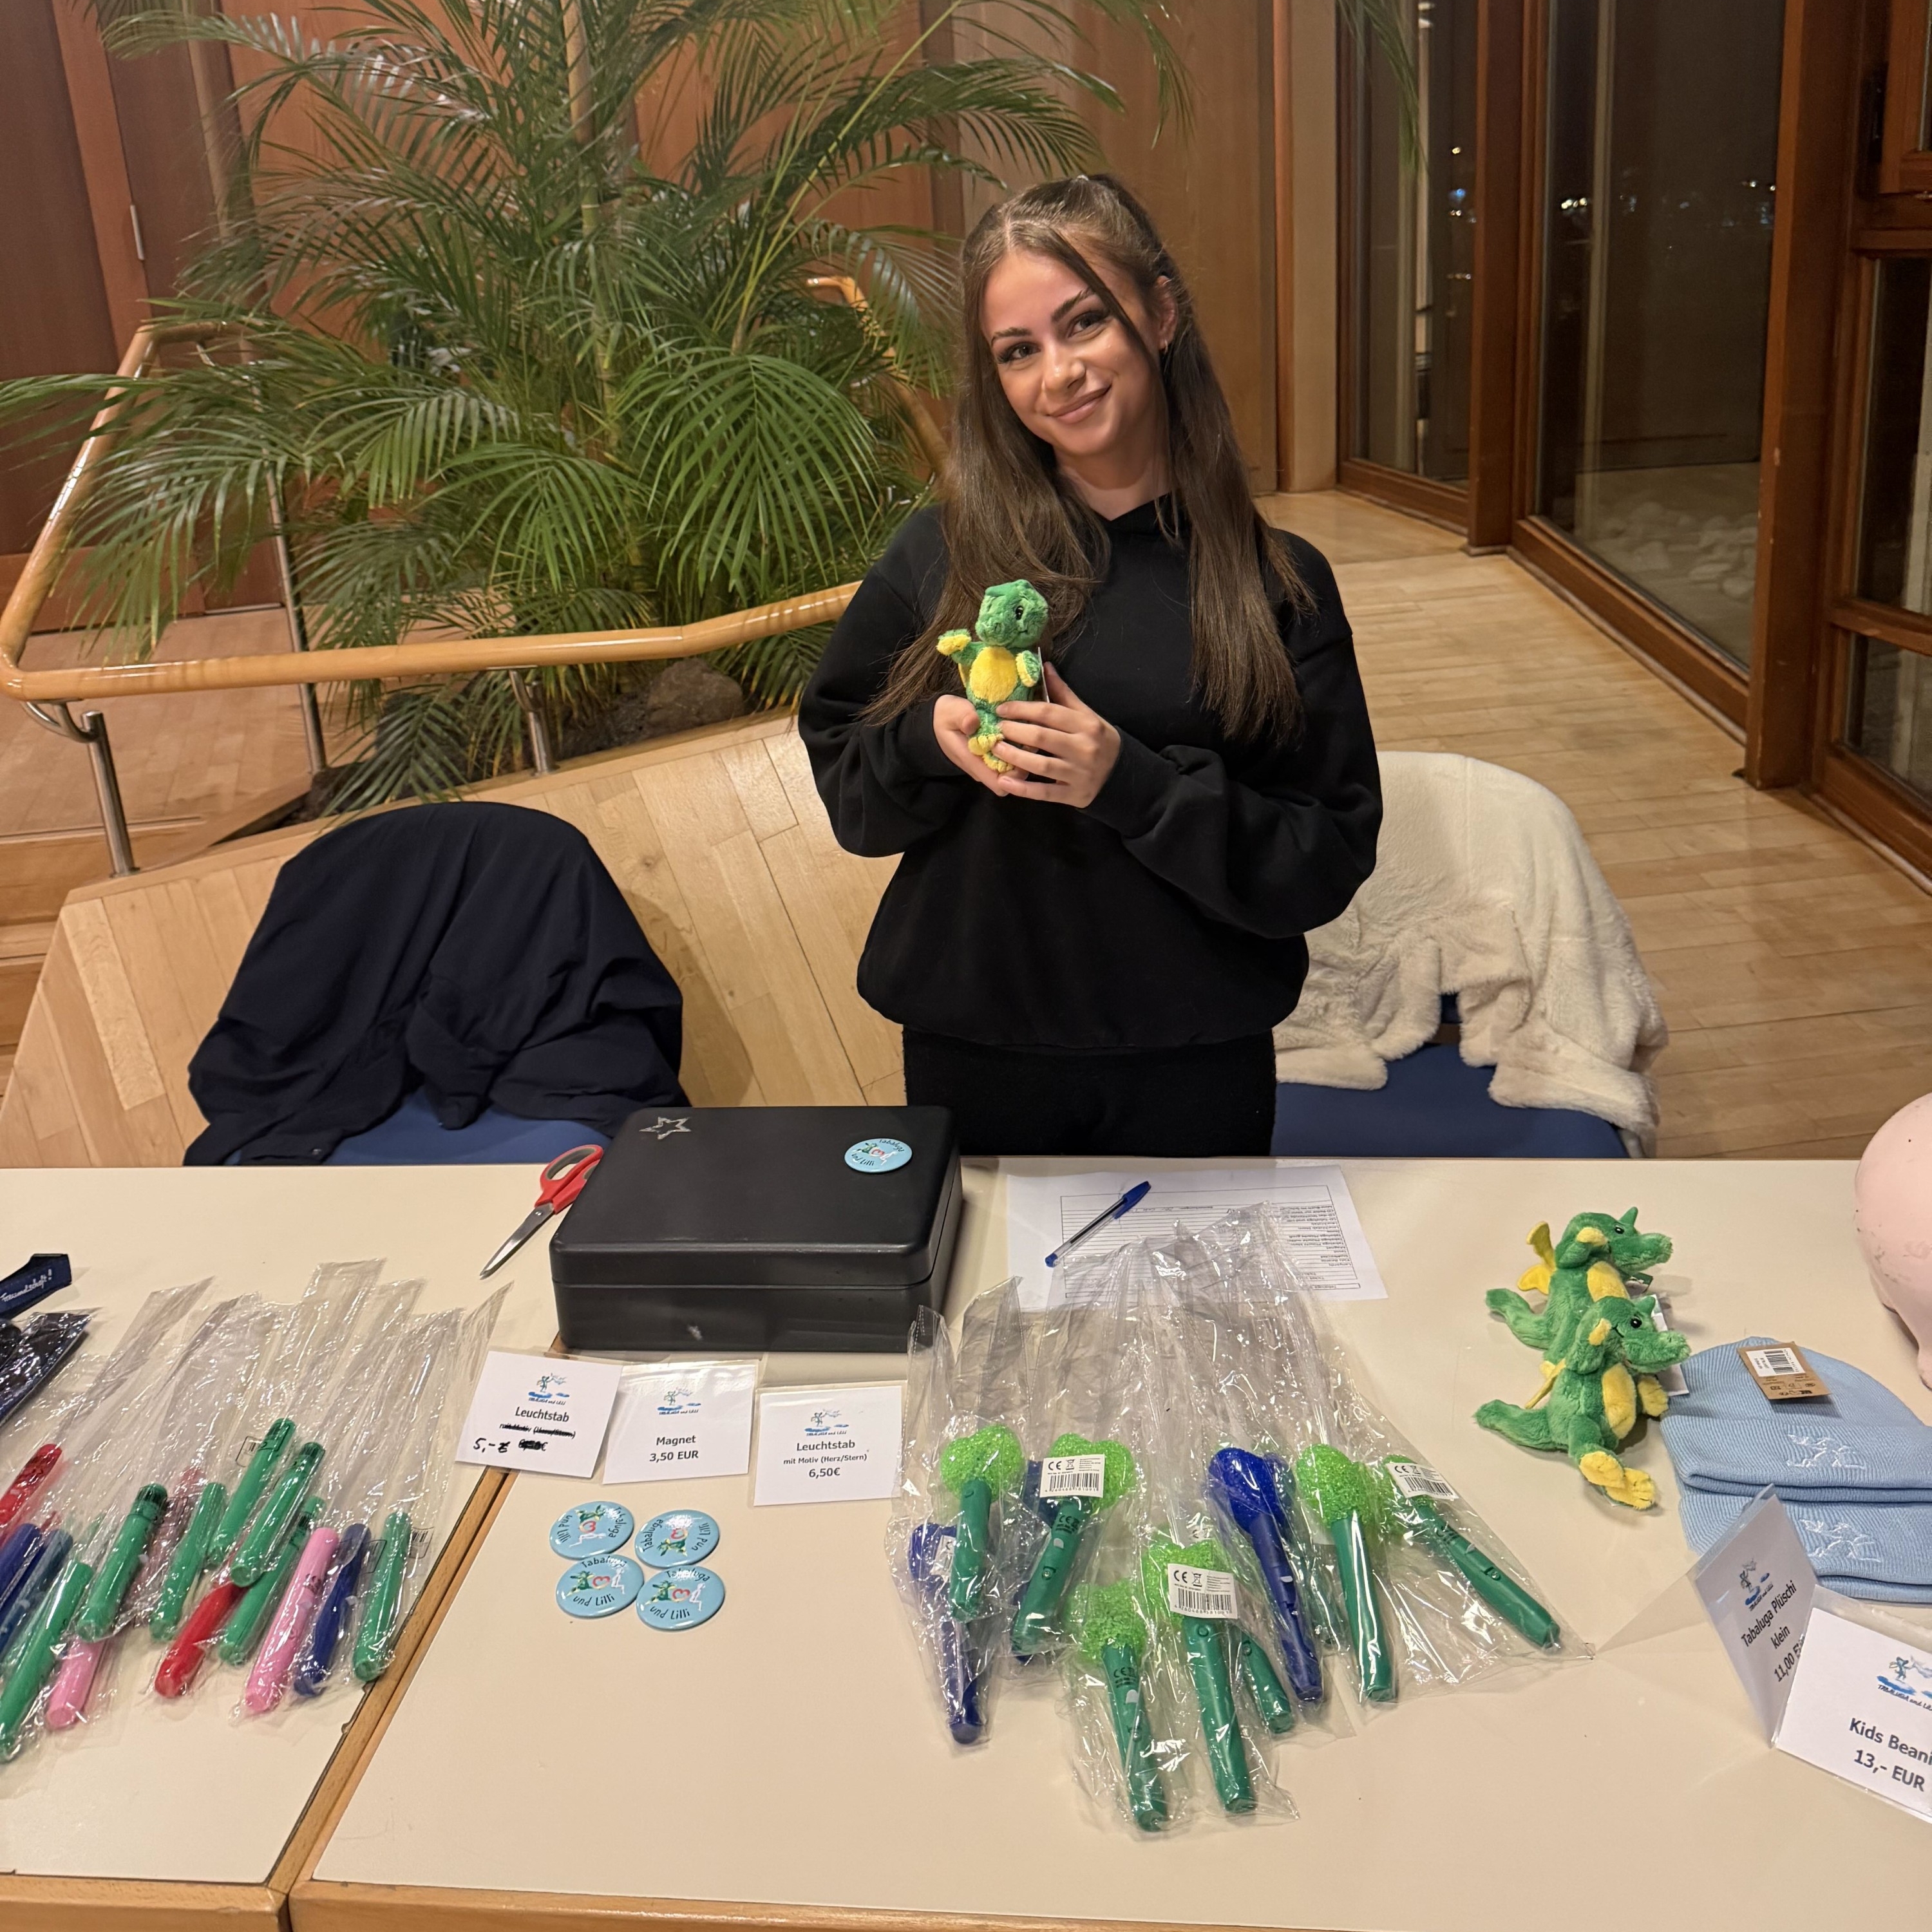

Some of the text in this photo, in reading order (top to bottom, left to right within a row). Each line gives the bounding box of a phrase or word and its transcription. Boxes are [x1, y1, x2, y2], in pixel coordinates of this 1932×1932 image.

[515, 1406, 569, 1423] Leuchtstab
[656, 1435, 696, 1446] Magnet
[797, 1439, 855, 1451] Leuchtstab
[649, 1450, 699, 1463] 3,50 EUR
[820, 1454, 867, 1464] (Herz/Stern)
[809, 1468, 840, 1479] 6,50€
[643, 1518, 664, 1552] Tabaluga
[691, 1522, 711, 1551] und Lilli
[573, 1593, 615, 1607] und Lilli
[650, 1605, 690, 1620] und Lilli
[1741, 1609, 1774, 1647] Tabaluga
[1771, 1580, 1797, 1614] Plüschi
[1770, 1625, 1791, 1650] klein
[1774, 1653, 1795, 1683] 11,00
[1849, 1718, 1884, 1744] Kids
[1854, 1749, 1926, 1792] 13,- EUR
